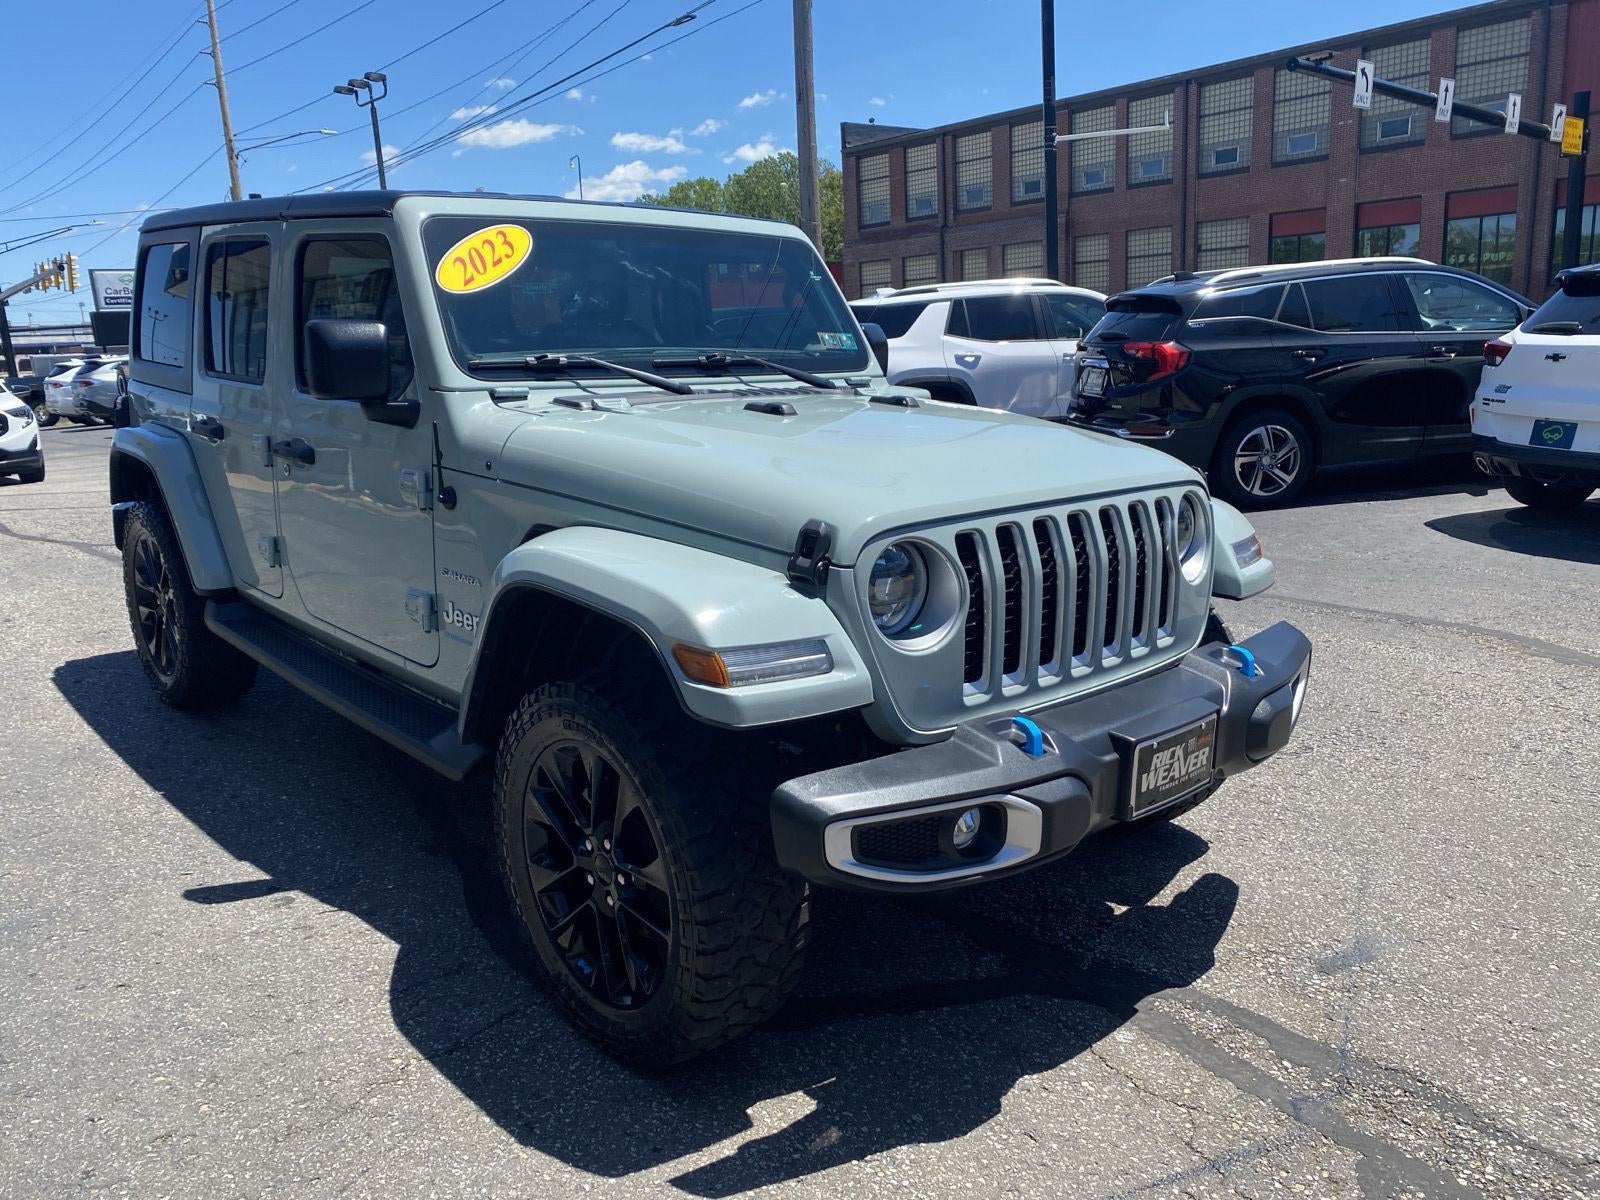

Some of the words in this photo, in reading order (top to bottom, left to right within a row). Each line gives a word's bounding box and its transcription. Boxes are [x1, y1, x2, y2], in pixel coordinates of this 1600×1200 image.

[1356, 94, 1369, 105] ONLY
[453, 230, 514, 287] 2023
[440, 567, 482, 587] SAHARA
[1141, 747, 1210, 793] WEAVER
[1150, 743, 1186, 771] RICK
